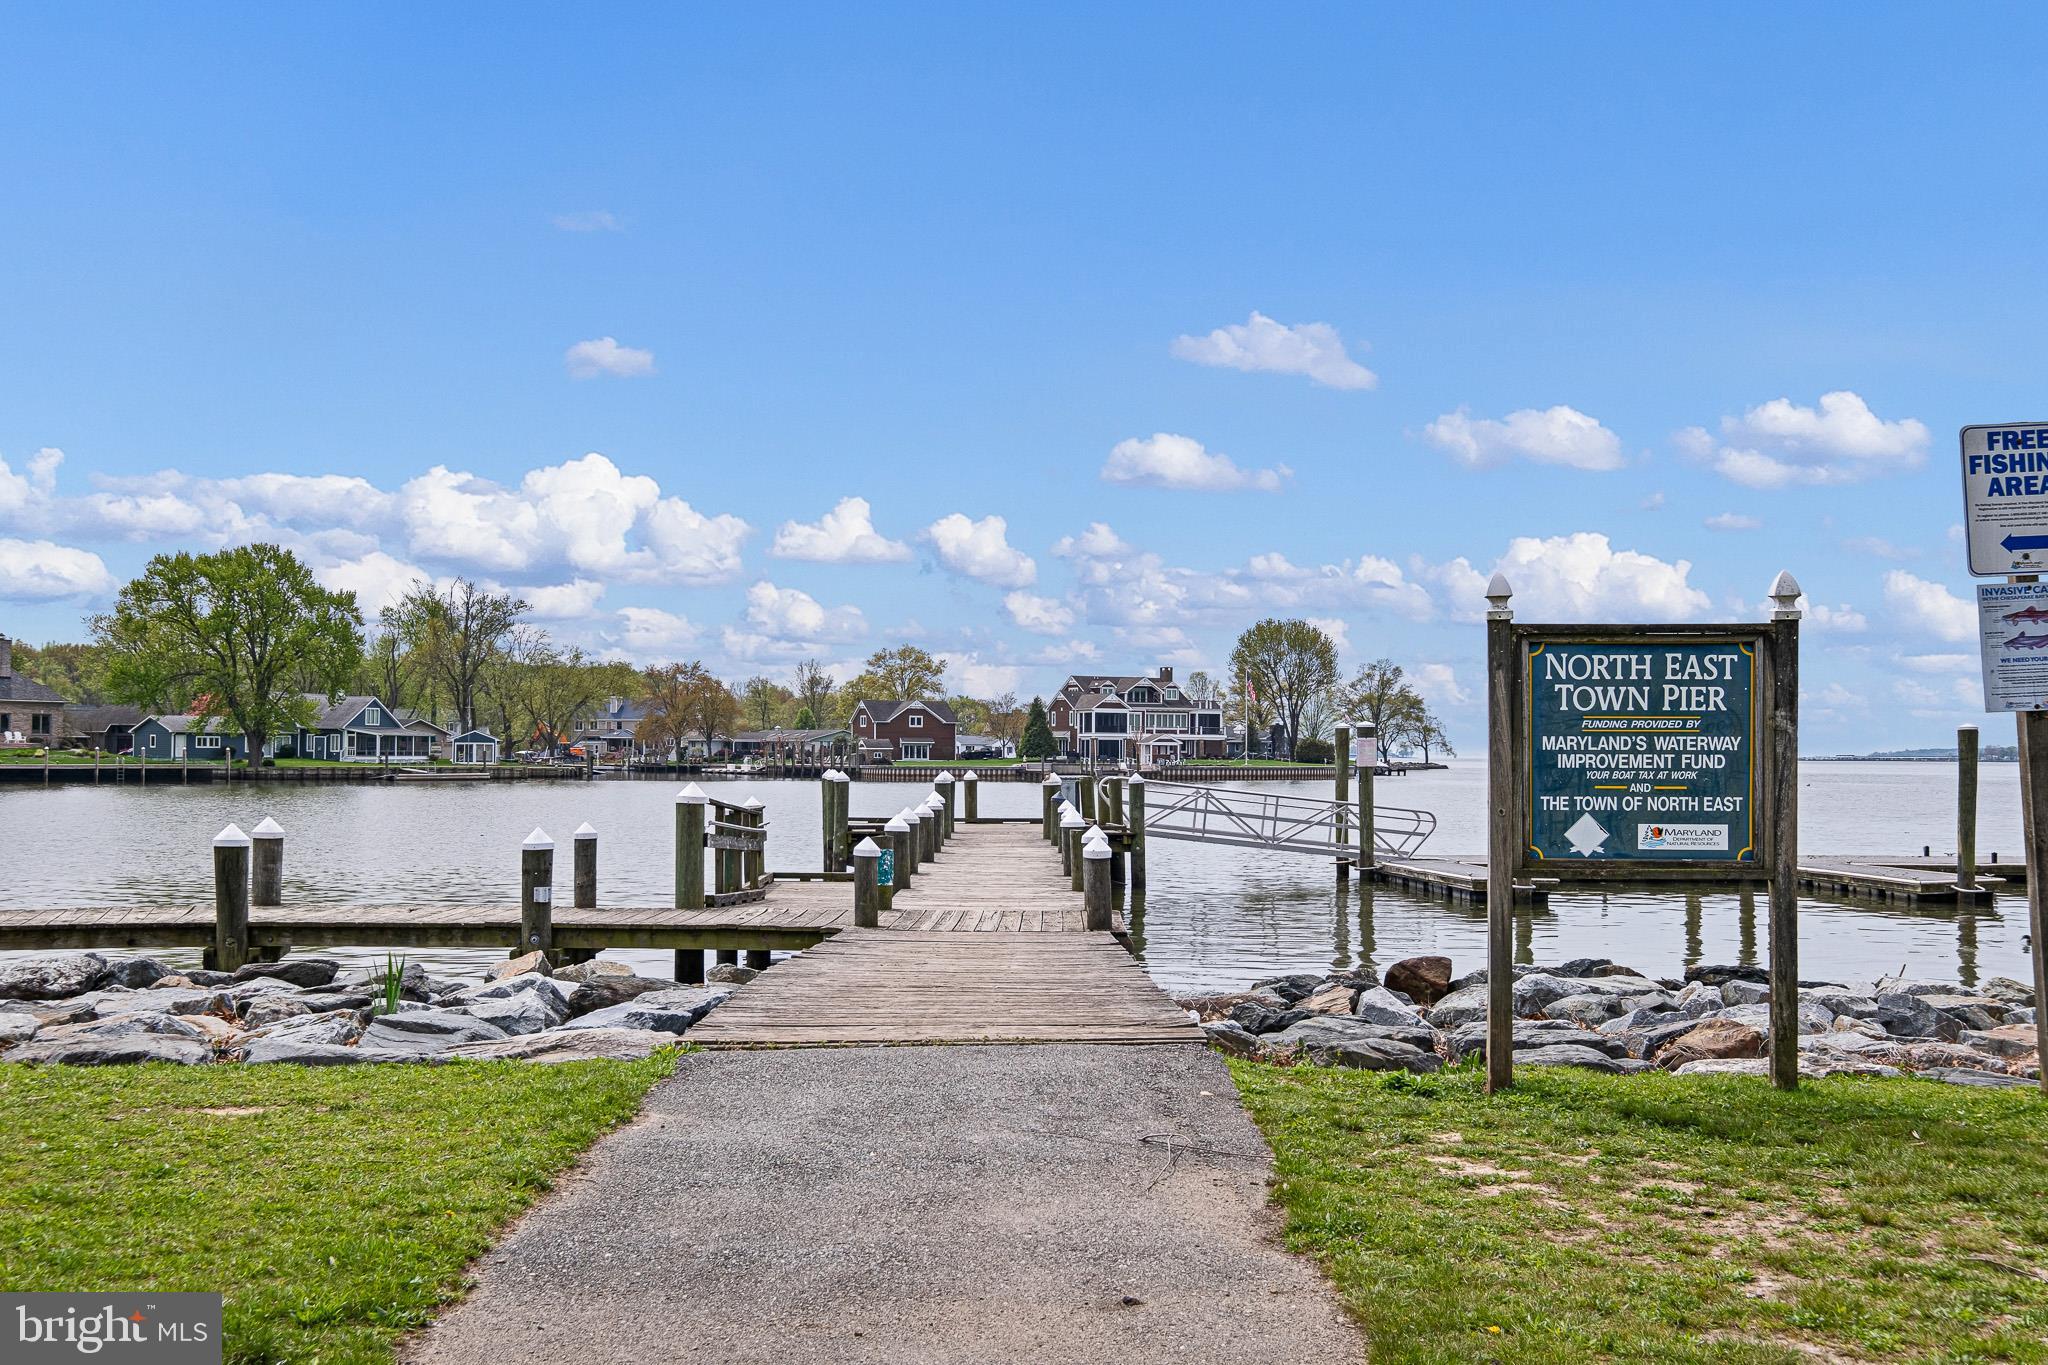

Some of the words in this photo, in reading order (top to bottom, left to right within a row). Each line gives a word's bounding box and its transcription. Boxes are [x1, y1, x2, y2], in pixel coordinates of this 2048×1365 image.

[1987, 429, 2048, 450] FREE
[1981, 587, 2031, 596] INVASIVE
[2033, 585, 2048, 594] CA
[1545, 653, 1652, 680] NORTH
[1665, 653, 1738, 680] EAST
[1554, 684, 1650, 711] TOWN
[1662, 684, 1727, 711] PIER
[1581, 720, 1628, 729] FUNDING
[1631, 720, 1683, 729] PROVIDED
[1686, 720, 1701, 729] BY
[1542, 736, 1647, 750] MARYLAND'S
[1654, 736, 1742, 750] WATERWAY
[1557, 754, 1675, 769] IMPROVEMENT
[1681, 754, 1726, 769] FUND
[1586, 771, 1610, 780] YOUR
[1612, 771, 1636, 780] BOAT
[1638, 771, 1655, 780] TAX
[1656, 771, 1669, 780] AT
[1671, 771, 1698, 780] WORK
[1629, 783, 1652, 793] AND
[1540, 796, 1570, 811] THE
[1573, 796, 1618, 811] TOWN
[1622, 796, 1643, 811] OF
[1647, 796, 1699, 812] NORTH
[1703, 796, 1743, 812] EAST
